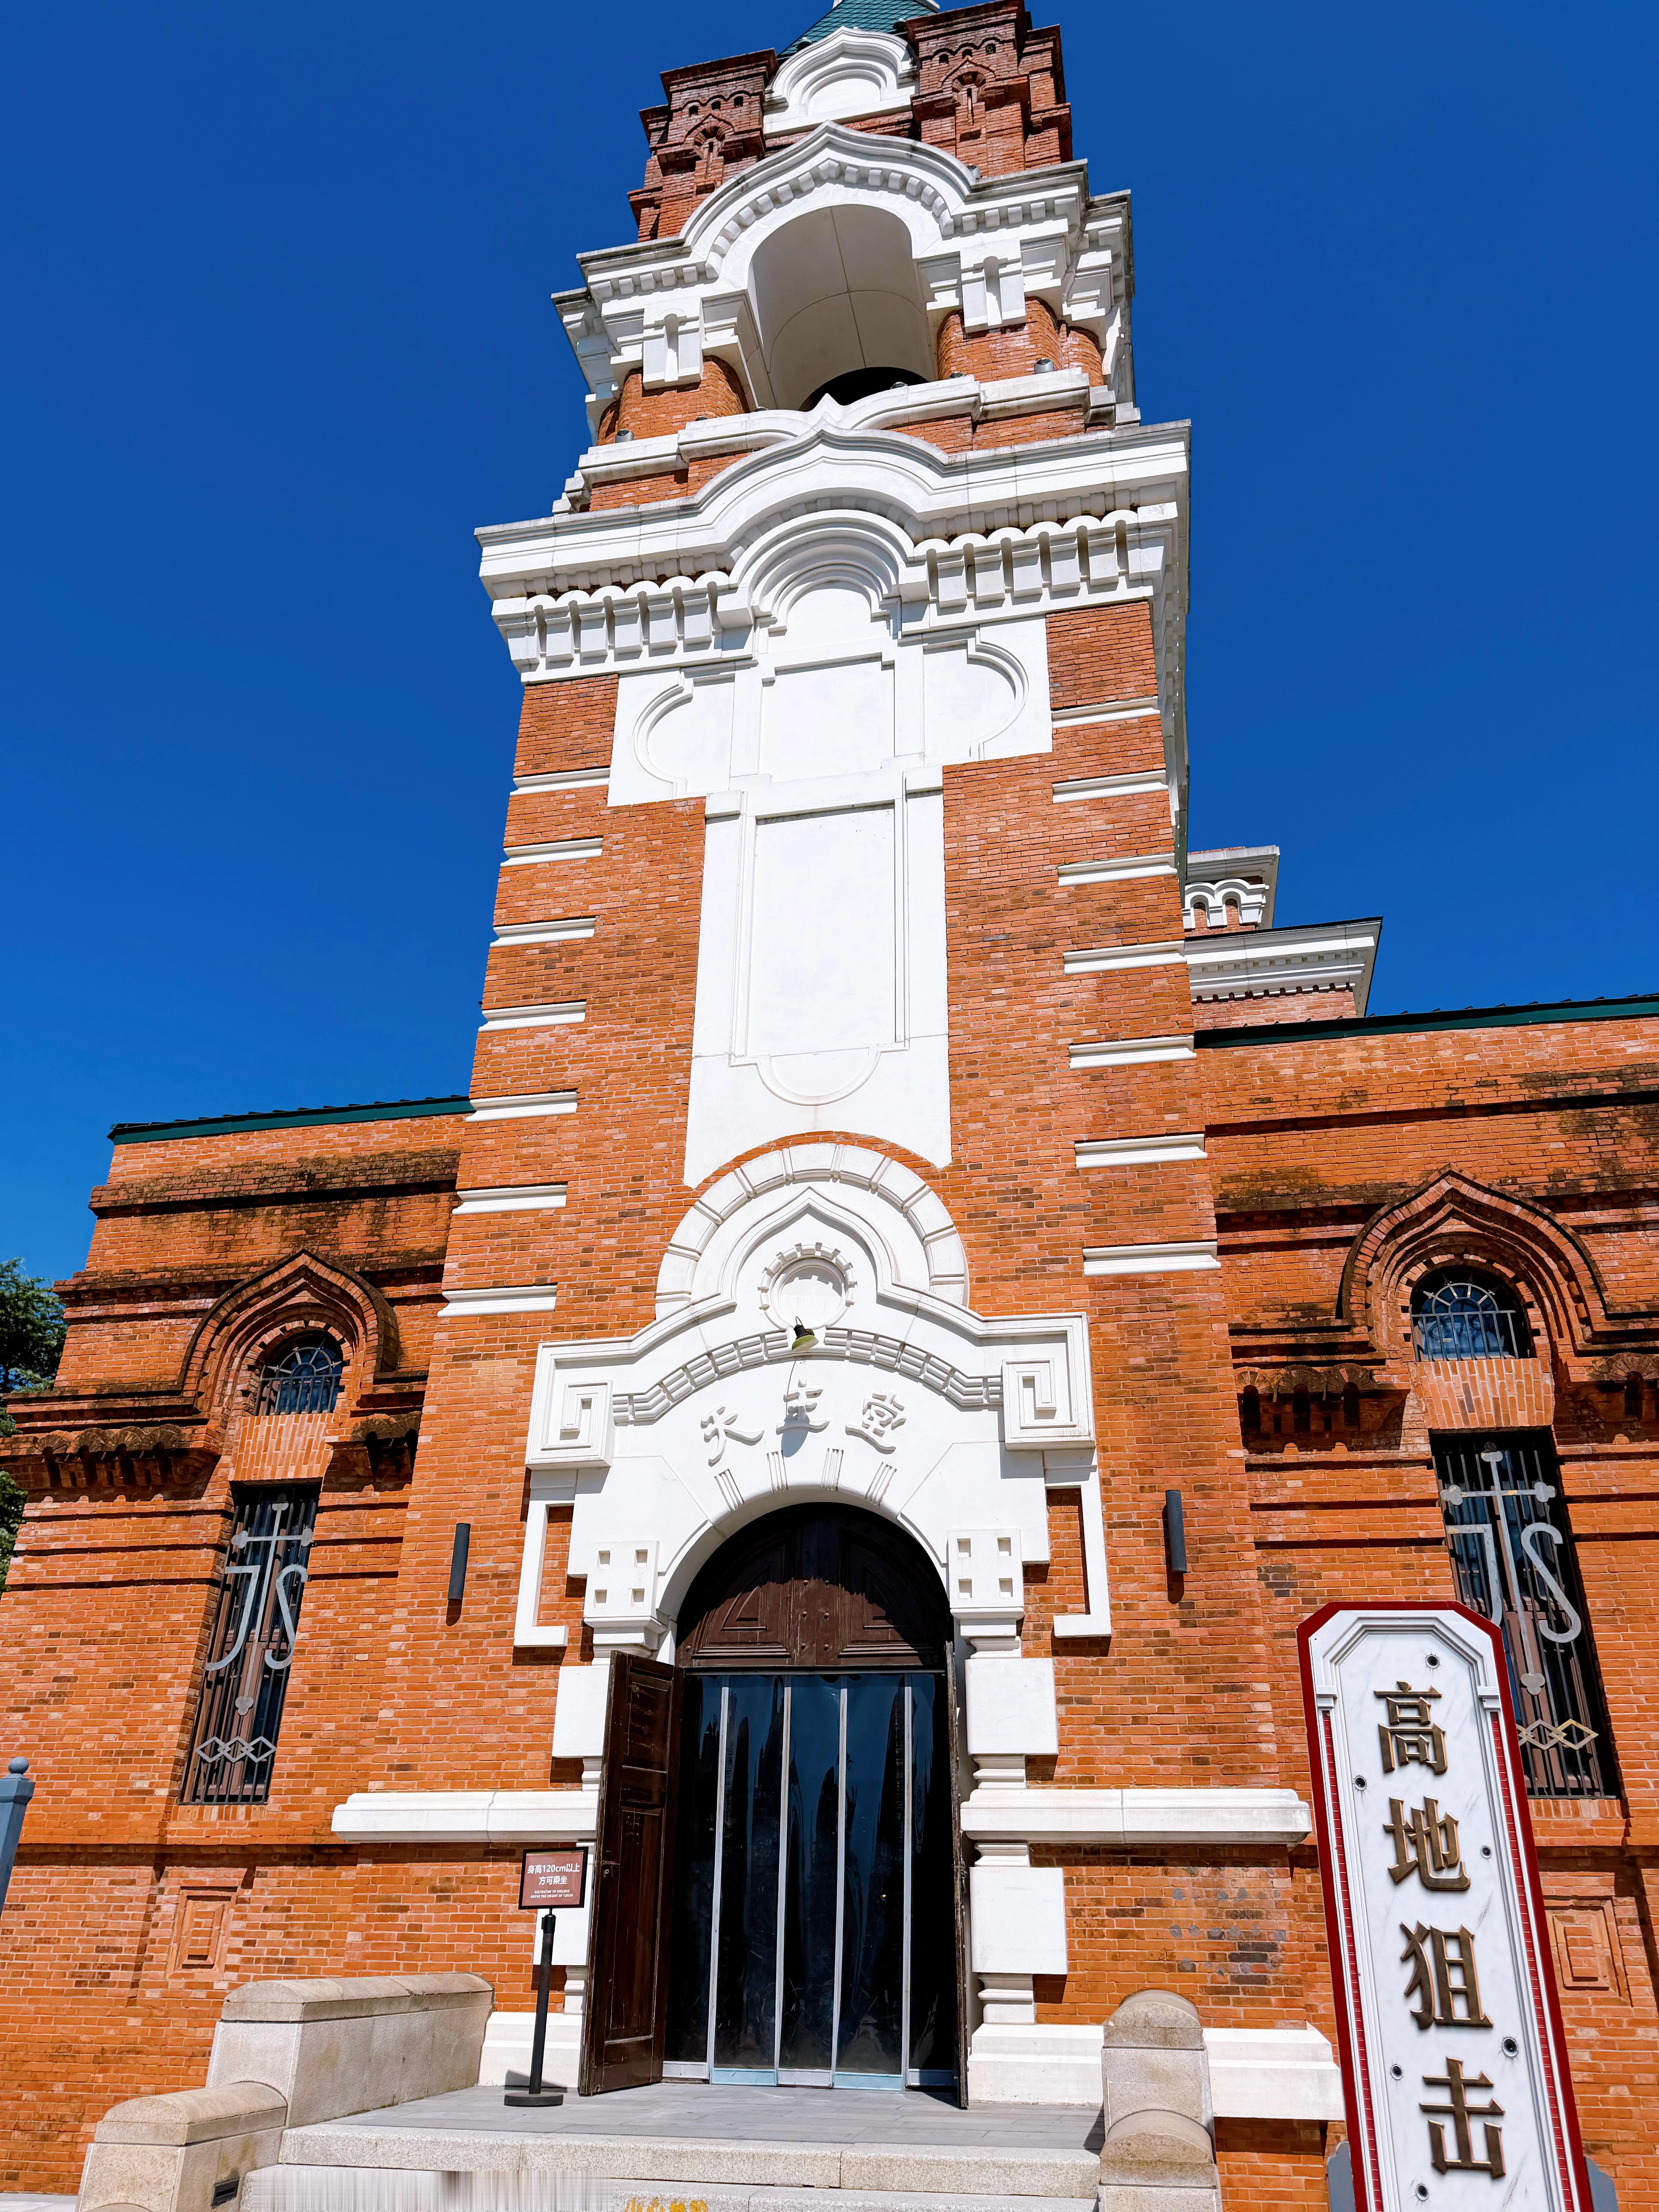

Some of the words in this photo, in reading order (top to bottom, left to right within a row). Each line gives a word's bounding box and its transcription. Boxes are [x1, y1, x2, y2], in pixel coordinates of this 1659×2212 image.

[700, 1377, 907, 1466] 天主堂
[527, 1863, 580, 1874] 身高120cm以上
[539, 1875, 567, 1885] 方可乘坐
[1374, 1681, 1506, 2178] 高地狙击
